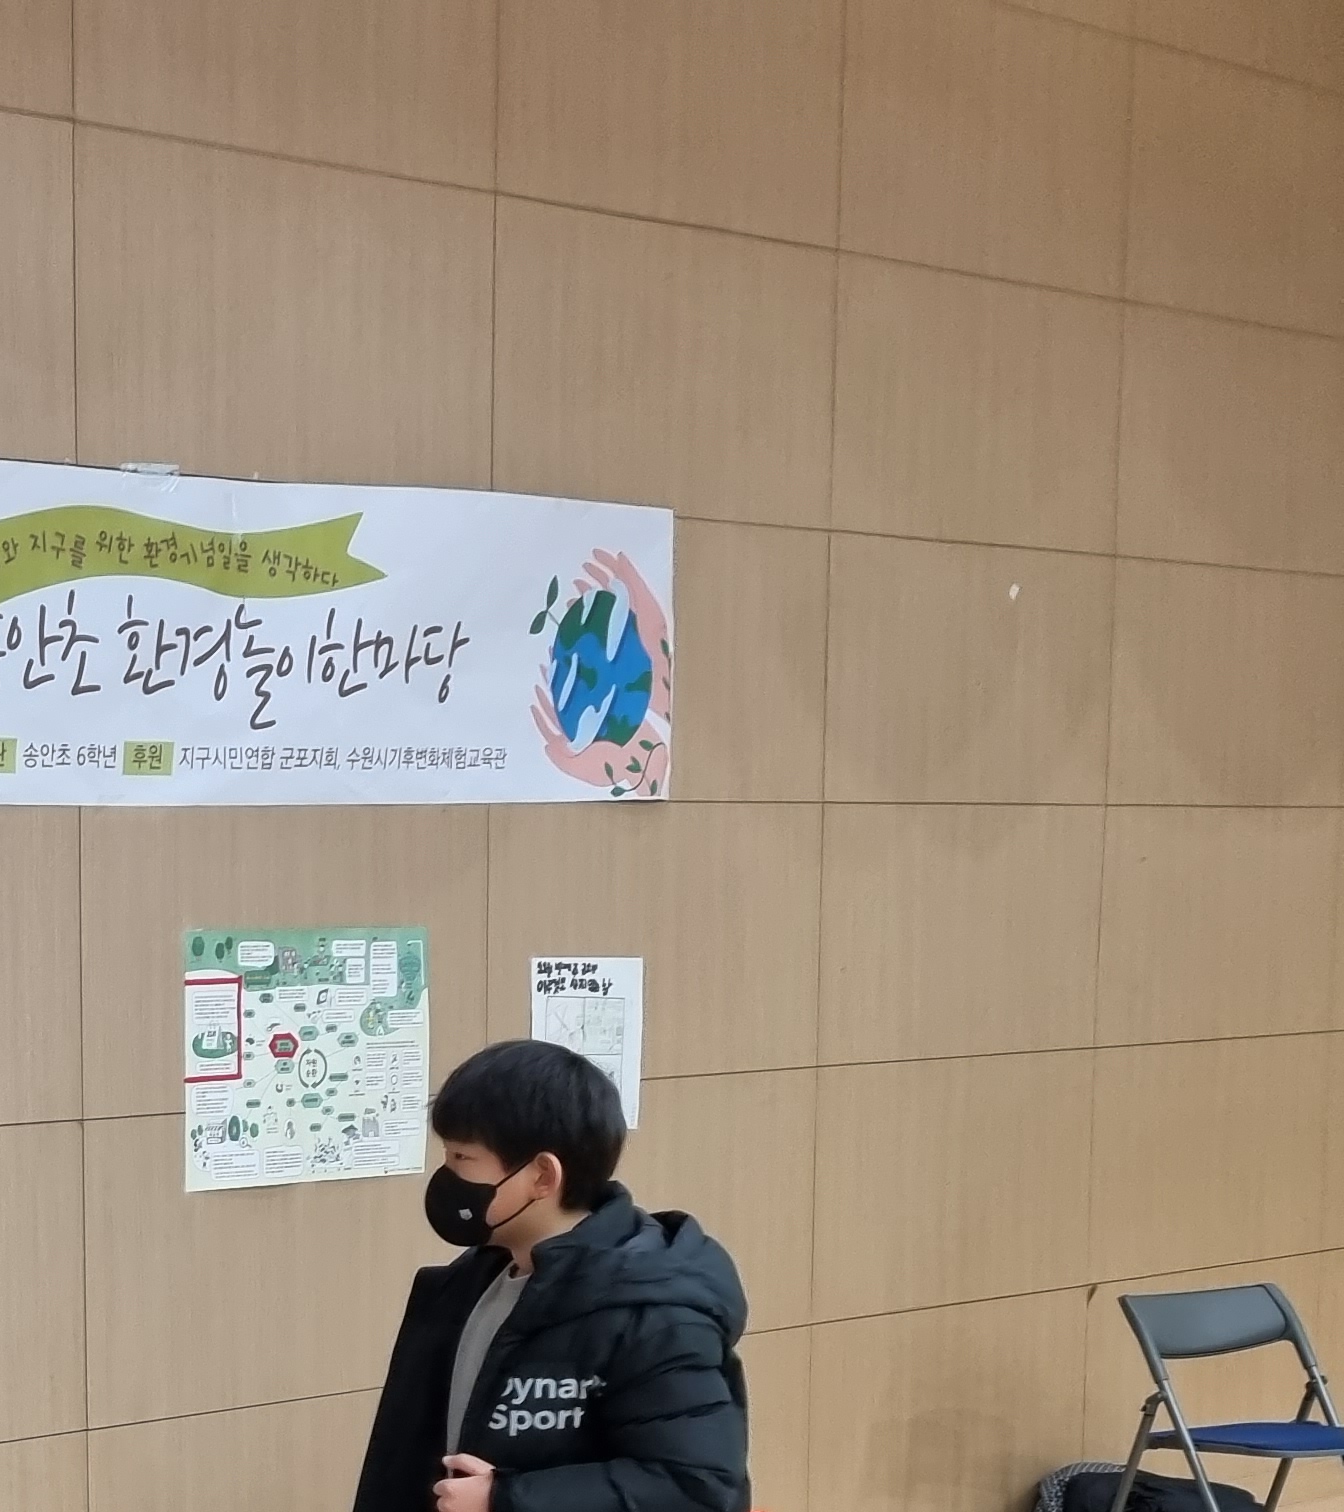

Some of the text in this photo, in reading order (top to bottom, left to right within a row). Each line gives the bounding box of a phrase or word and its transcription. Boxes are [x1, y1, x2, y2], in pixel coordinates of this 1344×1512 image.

[30, 532, 87, 569] 지구를
[96, 530, 135, 564] 위한
[143, 530, 252, 573] 환경기념일을
[261, 548, 339, 587] 생각하다
[22, 742, 72, 768] 송안초
[76, 744, 117, 769] 6학년
[132, 744, 163, 770] 후원
[179, 745, 276, 770] 지구시민연합
[279, 746, 341, 771] 군포지회,
[346, 746, 508, 770] 수원시기후변화체험교육관
[488, 1403, 585, 1437] Sport
